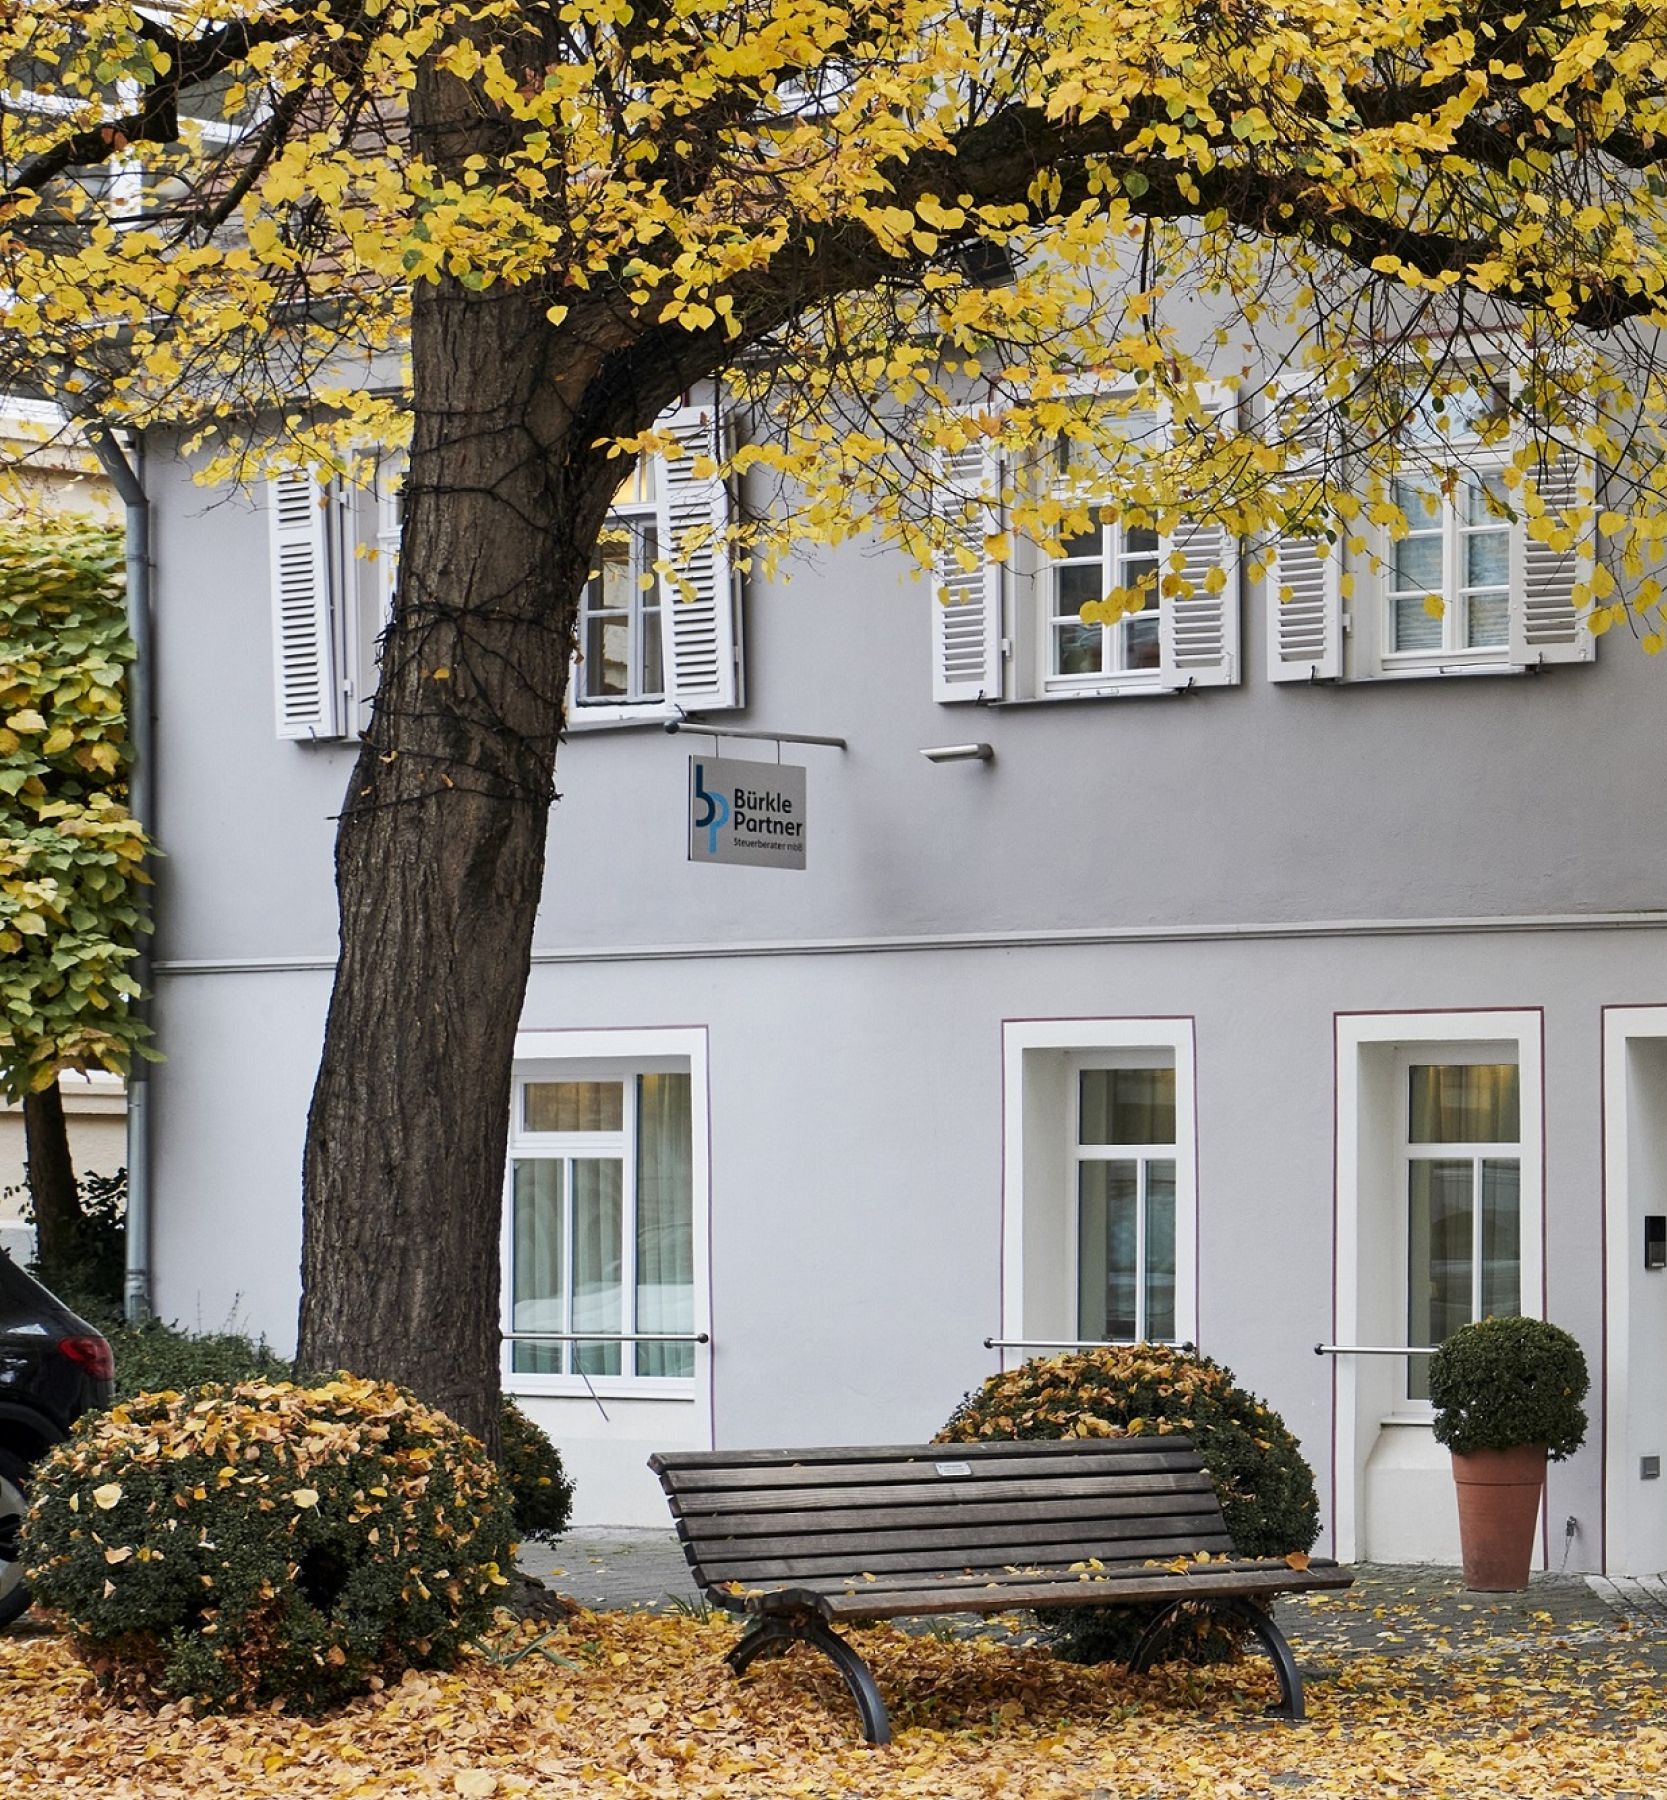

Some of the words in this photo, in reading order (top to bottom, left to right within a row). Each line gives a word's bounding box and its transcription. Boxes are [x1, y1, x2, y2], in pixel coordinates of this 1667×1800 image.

[734, 788, 793, 814] Bürkle
[734, 811, 803, 837] Partner
[733, 837, 786, 851] Steuerberater
